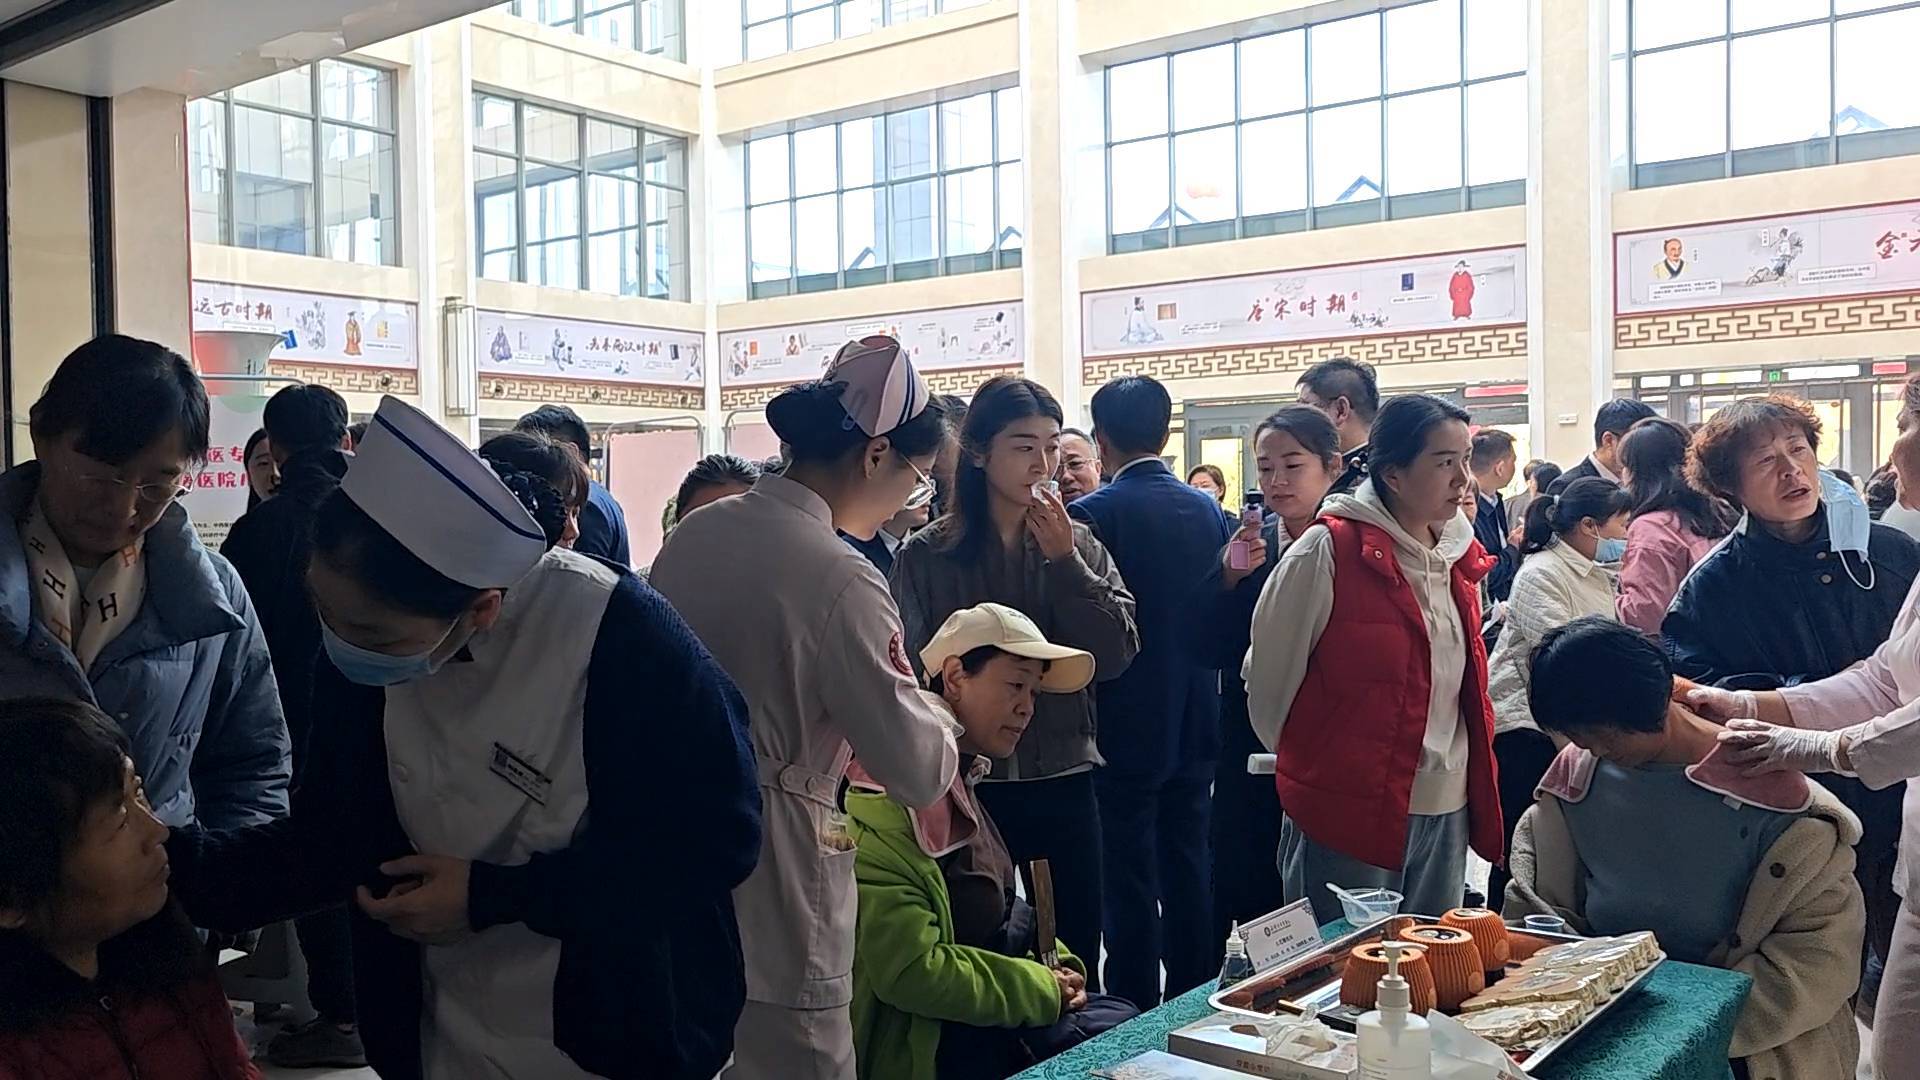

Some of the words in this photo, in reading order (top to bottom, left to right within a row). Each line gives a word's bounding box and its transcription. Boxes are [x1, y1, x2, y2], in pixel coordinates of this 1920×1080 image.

[194, 298, 272, 320] 远古时期
[1248, 293, 1345, 322] 唐宋时期
[43, 568, 67, 599] H
[97, 592, 118, 623] H
